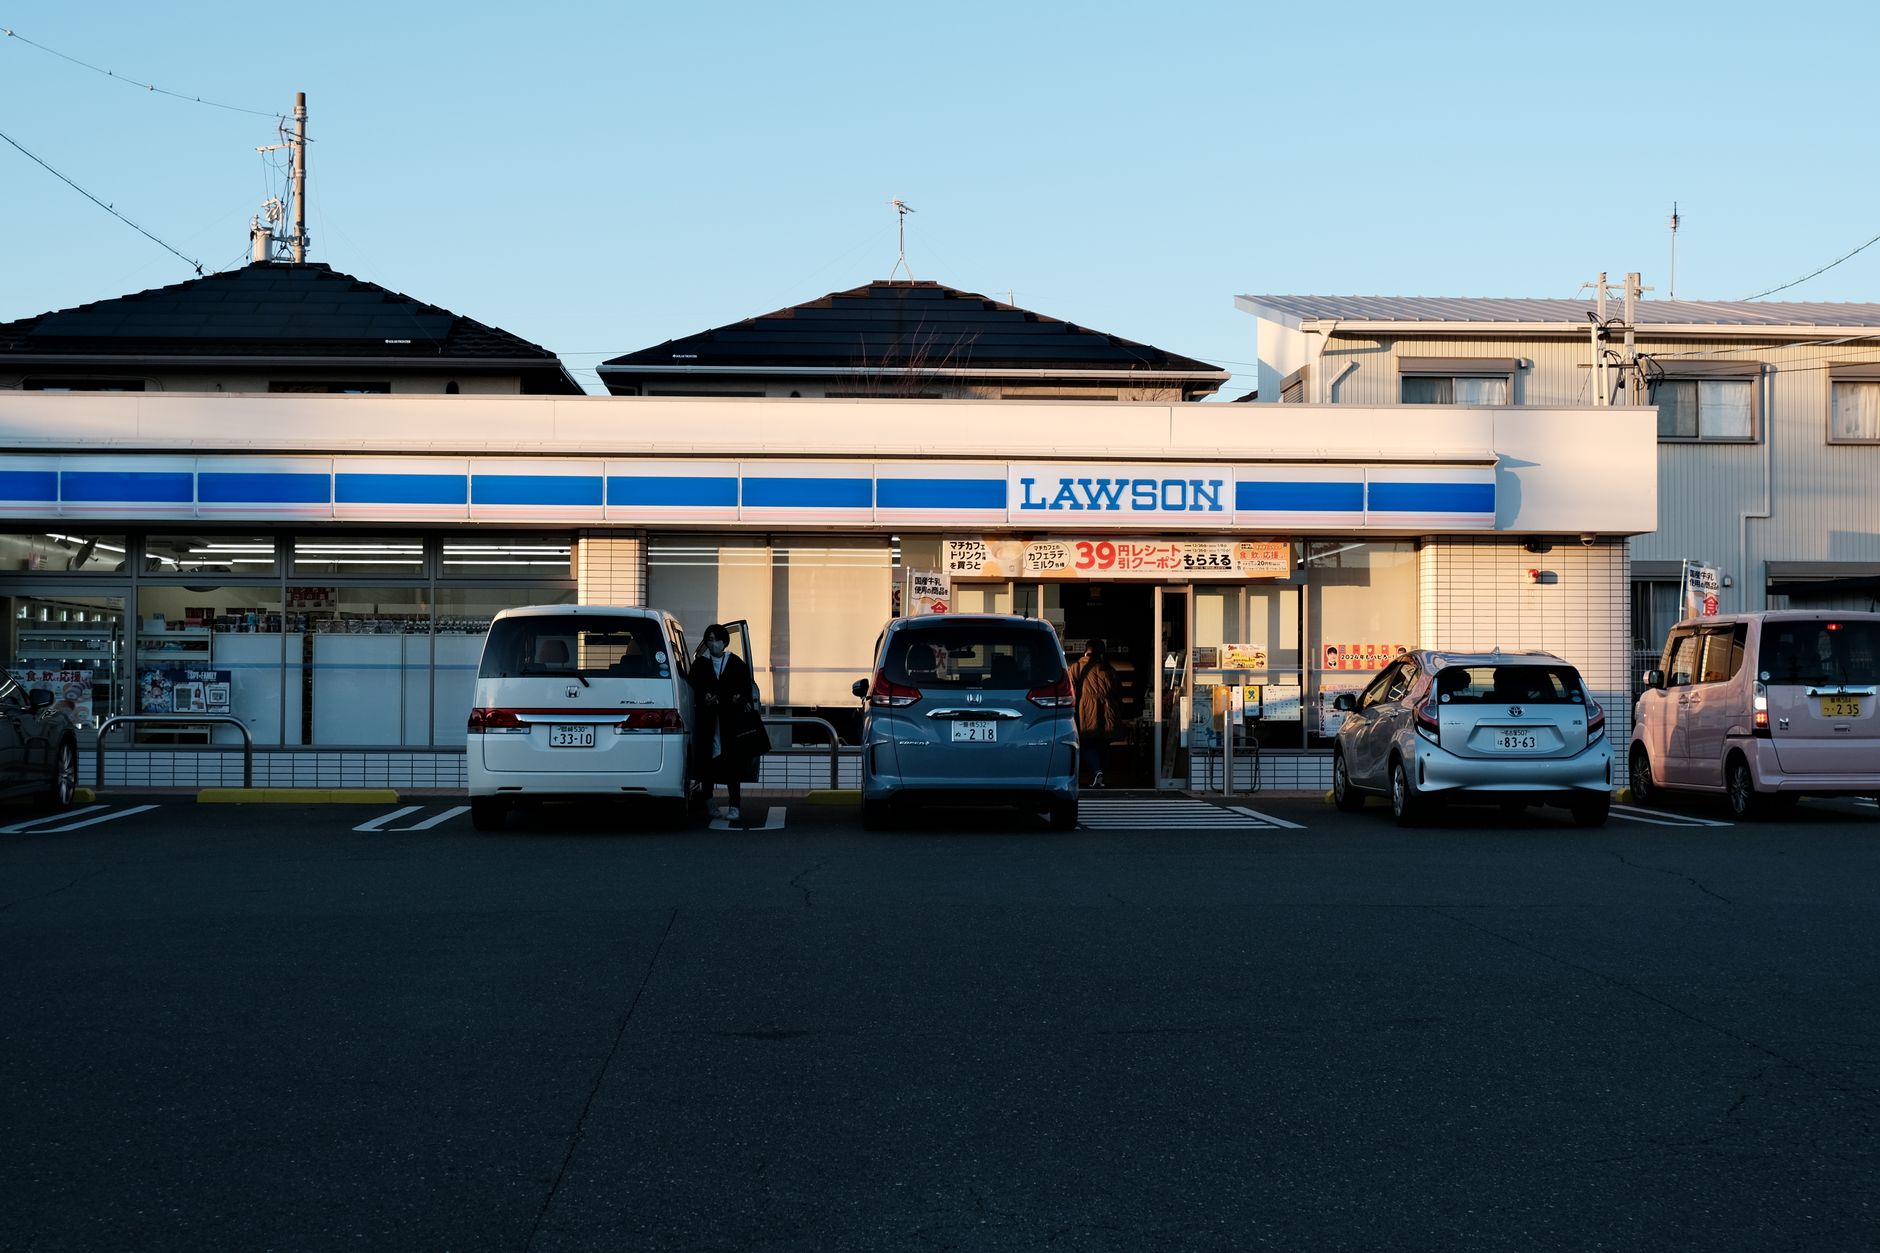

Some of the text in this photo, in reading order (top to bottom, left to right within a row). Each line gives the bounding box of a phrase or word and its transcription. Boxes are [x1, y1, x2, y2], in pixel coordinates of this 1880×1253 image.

[1020, 477, 1223, 511] LAWSON
[949, 541, 985, 551] マチカフェ
[1075, 541, 1116, 569] 39
[1183, 554, 1232, 566] もらえる
[949, 561, 981, 570] を買うと
[914, 576, 942, 586] 国産牛乳
[560, 733, 592, 745] 33-10
[1504, 737, 1536, 748] 83-63
